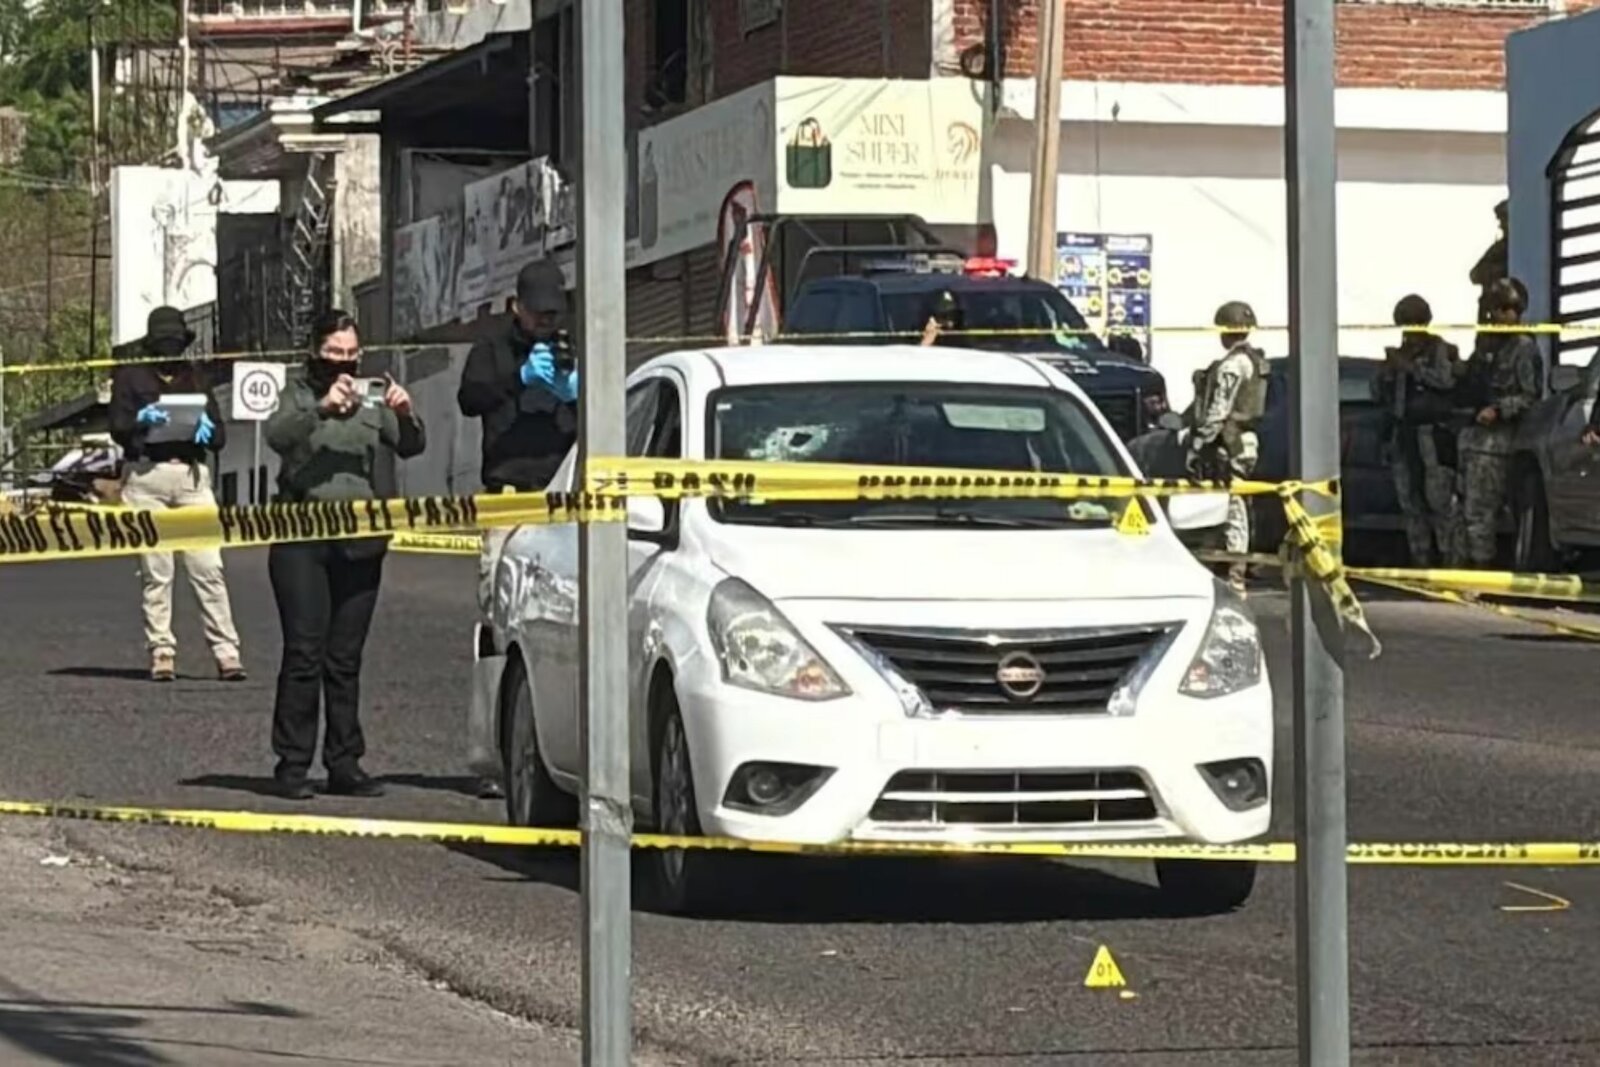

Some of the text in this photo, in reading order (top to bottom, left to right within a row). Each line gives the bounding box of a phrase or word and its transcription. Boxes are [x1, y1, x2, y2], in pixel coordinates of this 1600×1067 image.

[248, 380, 271, 398] 40
[50, 503, 85, 551] EL
[87, 509, 159, 549] PASO
[218, 500, 359, 543] PROHIBIDO
[1096, 962, 1112, 977] 01
